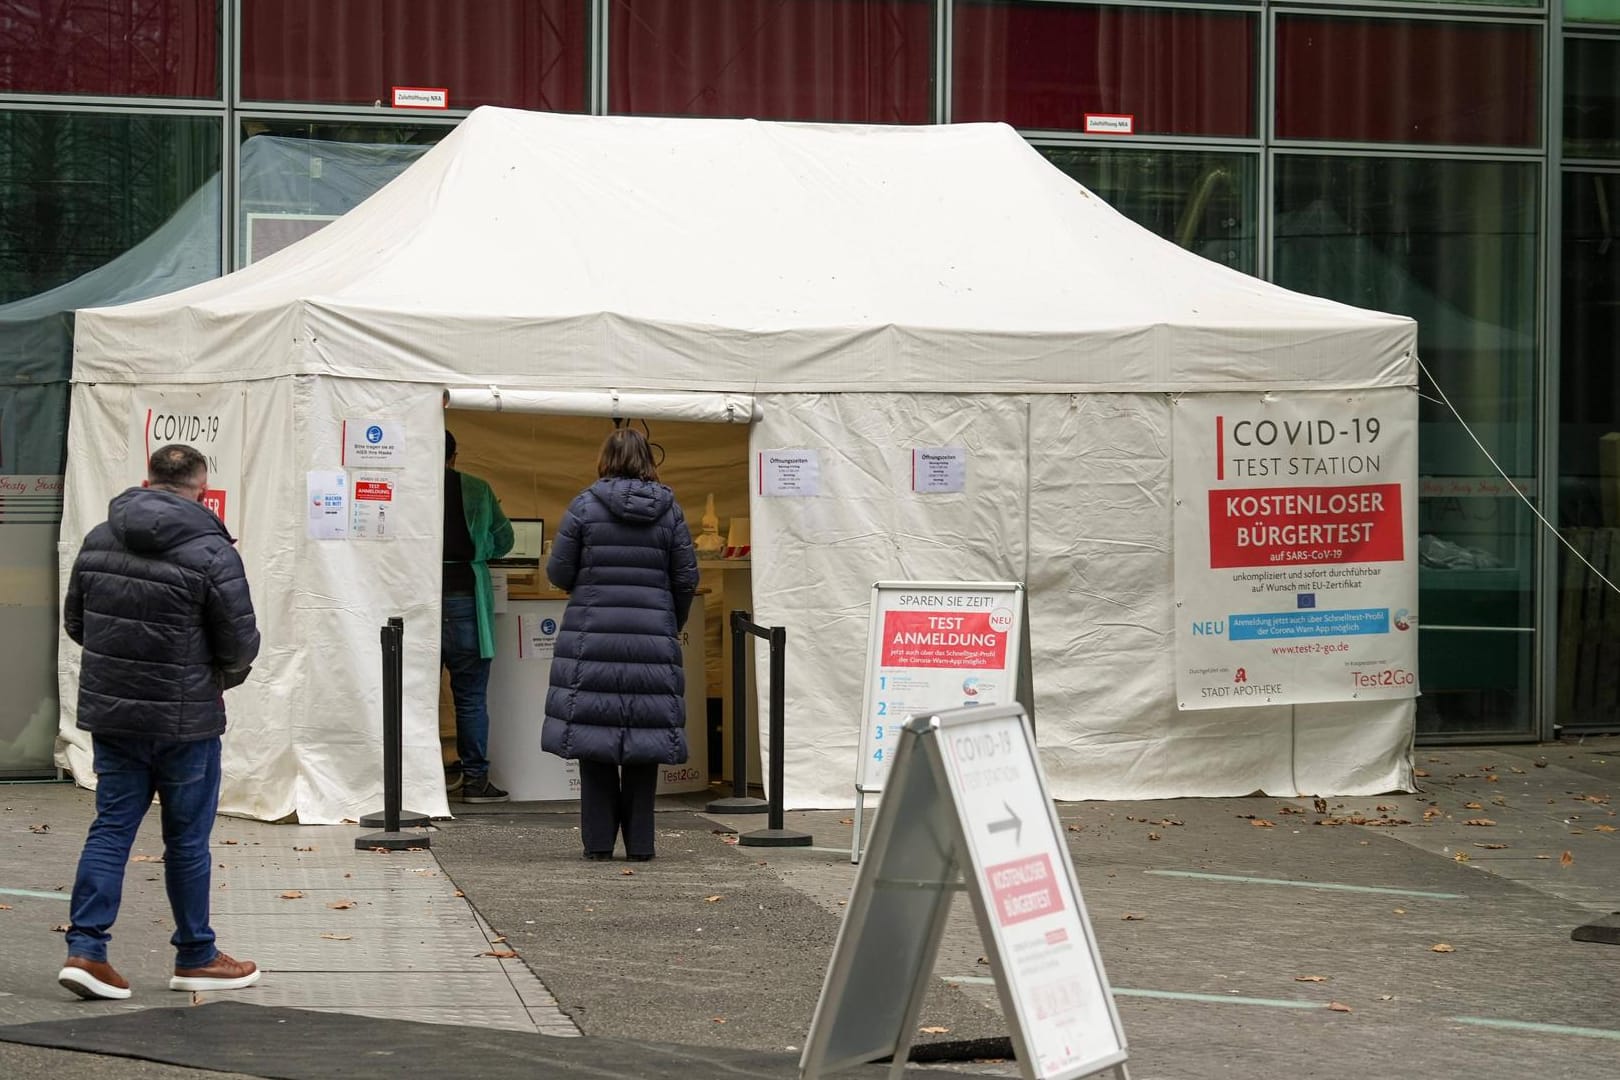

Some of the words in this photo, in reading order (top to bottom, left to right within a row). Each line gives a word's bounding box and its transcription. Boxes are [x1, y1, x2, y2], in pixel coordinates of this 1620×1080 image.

[153, 414, 219, 442] COVID-19
[1233, 417, 1381, 446] COVID-19
[1232, 457, 1282, 477] TEST
[1288, 455, 1381, 475] STATION
[1226, 492, 1385, 518] KOSTENLOSER
[1236, 521, 1375, 548] BÜRGERTEST
[1270, 551, 1285, 562] auf
[1286, 549, 1343, 561] SARS-CoV-19
[1233, 572, 1287, 583] unkompliziert
[1288, 571, 1303, 580] und
[1304, 570, 1327, 579] sofort
[1328, 567, 1382, 578] durchführbar
[1251, 583, 1264, 593] auf
[1266, 582, 1297, 592] Wunsch
[1297, 582, 1310, 591] mit
[1312, 580, 1362, 590] EU-Zertifikat
[899, 595, 944, 606] SPAREN
[946, 596, 963, 607] SIE
[966, 596, 994, 607] ZEIT!
[928, 616, 965, 630] TEST
[991, 616, 1011, 625] NEU
[1233, 617, 1272, 627] Anmeldung
[1272, 616, 1289, 626] jetzt
[1290, 615, 1306, 624] auch
[1192, 620, 1225, 636] NEU
[1257, 627, 1269, 635] der
[1270, 625, 1295, 635] Corona
[1315, 624, 1330, 634] App
[893, 632, 996, 647] ANMELDUNG
[1271, 643, 1349, 655] www.test-2-go.de
[880, 676, 887, 690] 1
[1351, 669, 1415, 688] Test2Go
[1201, 686, 1230, 698] STADT
[1233, 683, 1282, 696] APOTHEKE
[877, 702, 887, 716] 2
[875, 726, 884, 739] 3
[955, 729, 1013, 763] COVID-19
[873, 749, 884, 761] 4
[662, 768, 700, 782] Test2Go
